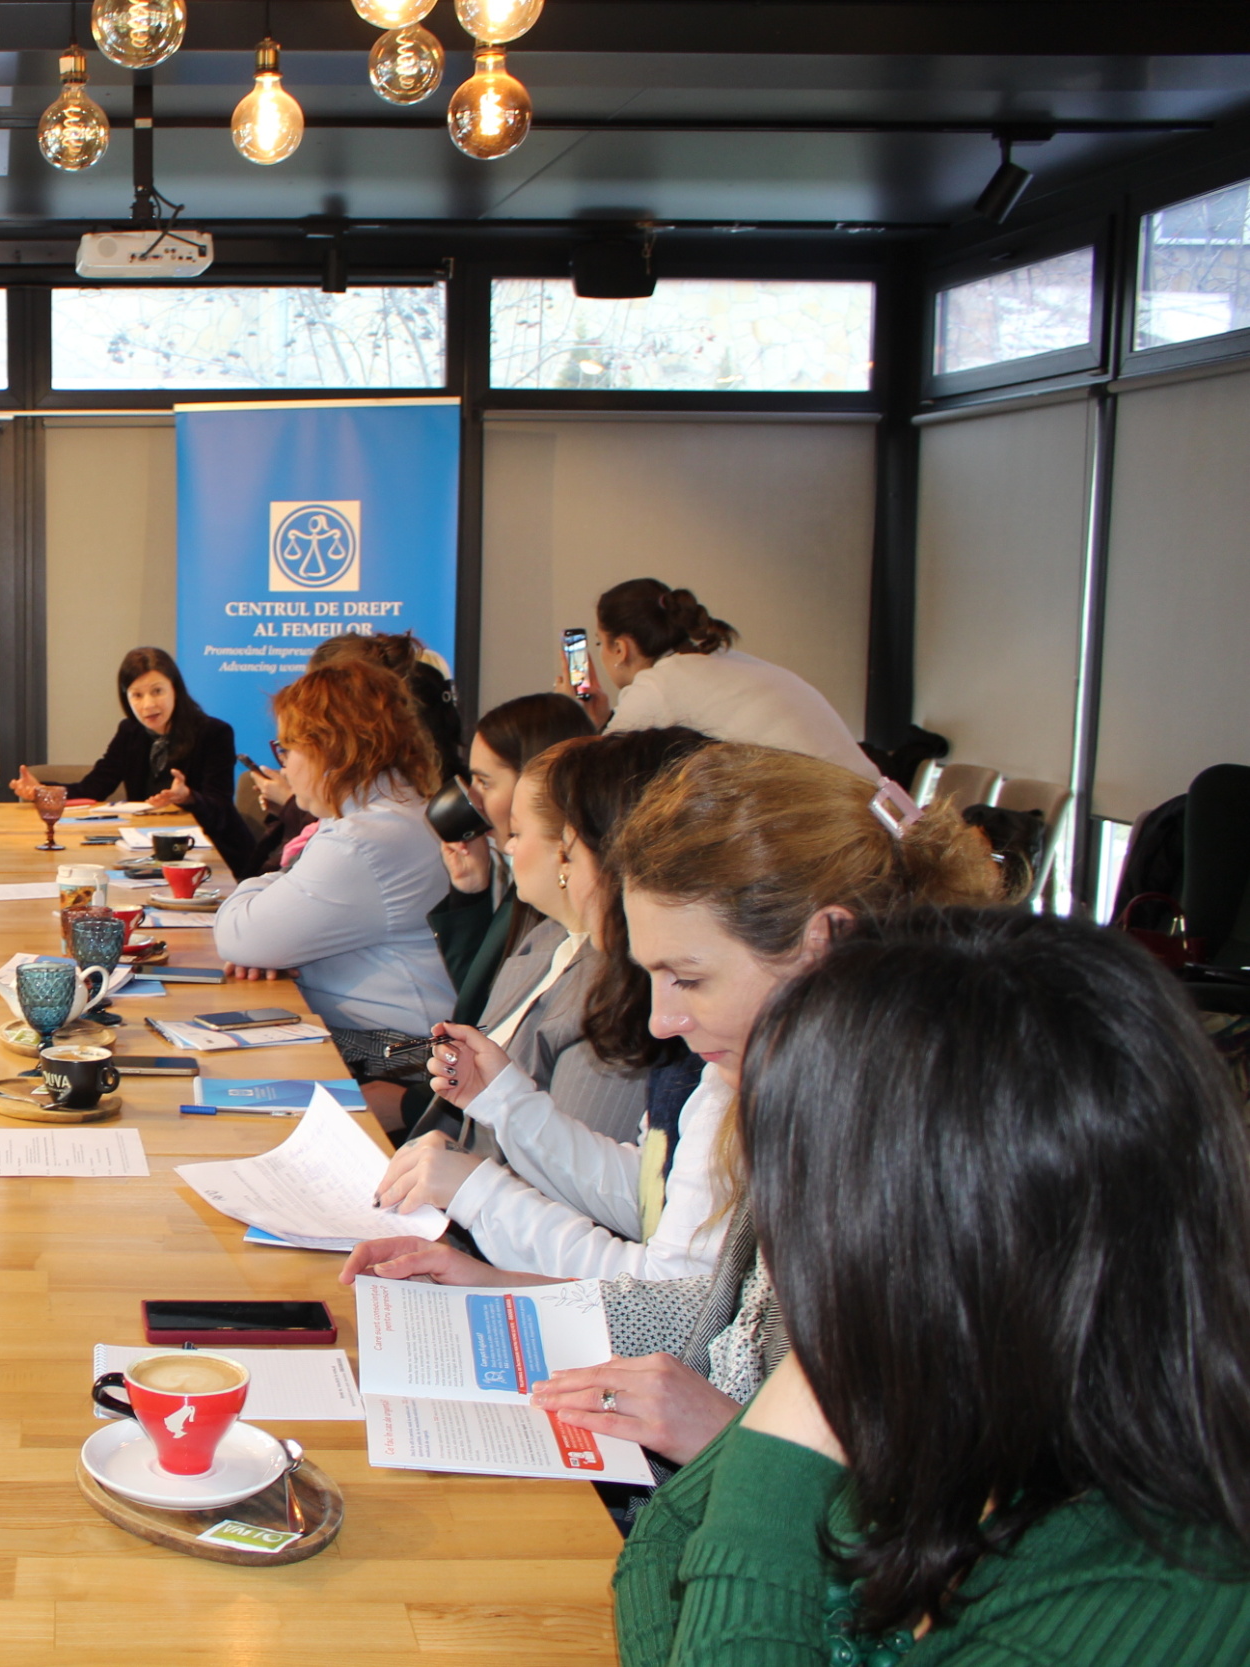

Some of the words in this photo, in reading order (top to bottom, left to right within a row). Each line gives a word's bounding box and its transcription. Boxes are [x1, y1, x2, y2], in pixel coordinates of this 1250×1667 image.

[225, 601, 310, 617] CENTRUL
[314, 601, 340, 616] DE
[343, 601, 403, 616] DREPT
[253, 622, 278, 637] AL
[281, 622, 373, 637] FEMEILOR
[268, 645, 316, 658] împreun
[219, 661, 277, 674] Advancing
[279, 664, 307, 672] wom
[222, 1524, 284, 1543] OLIVA
